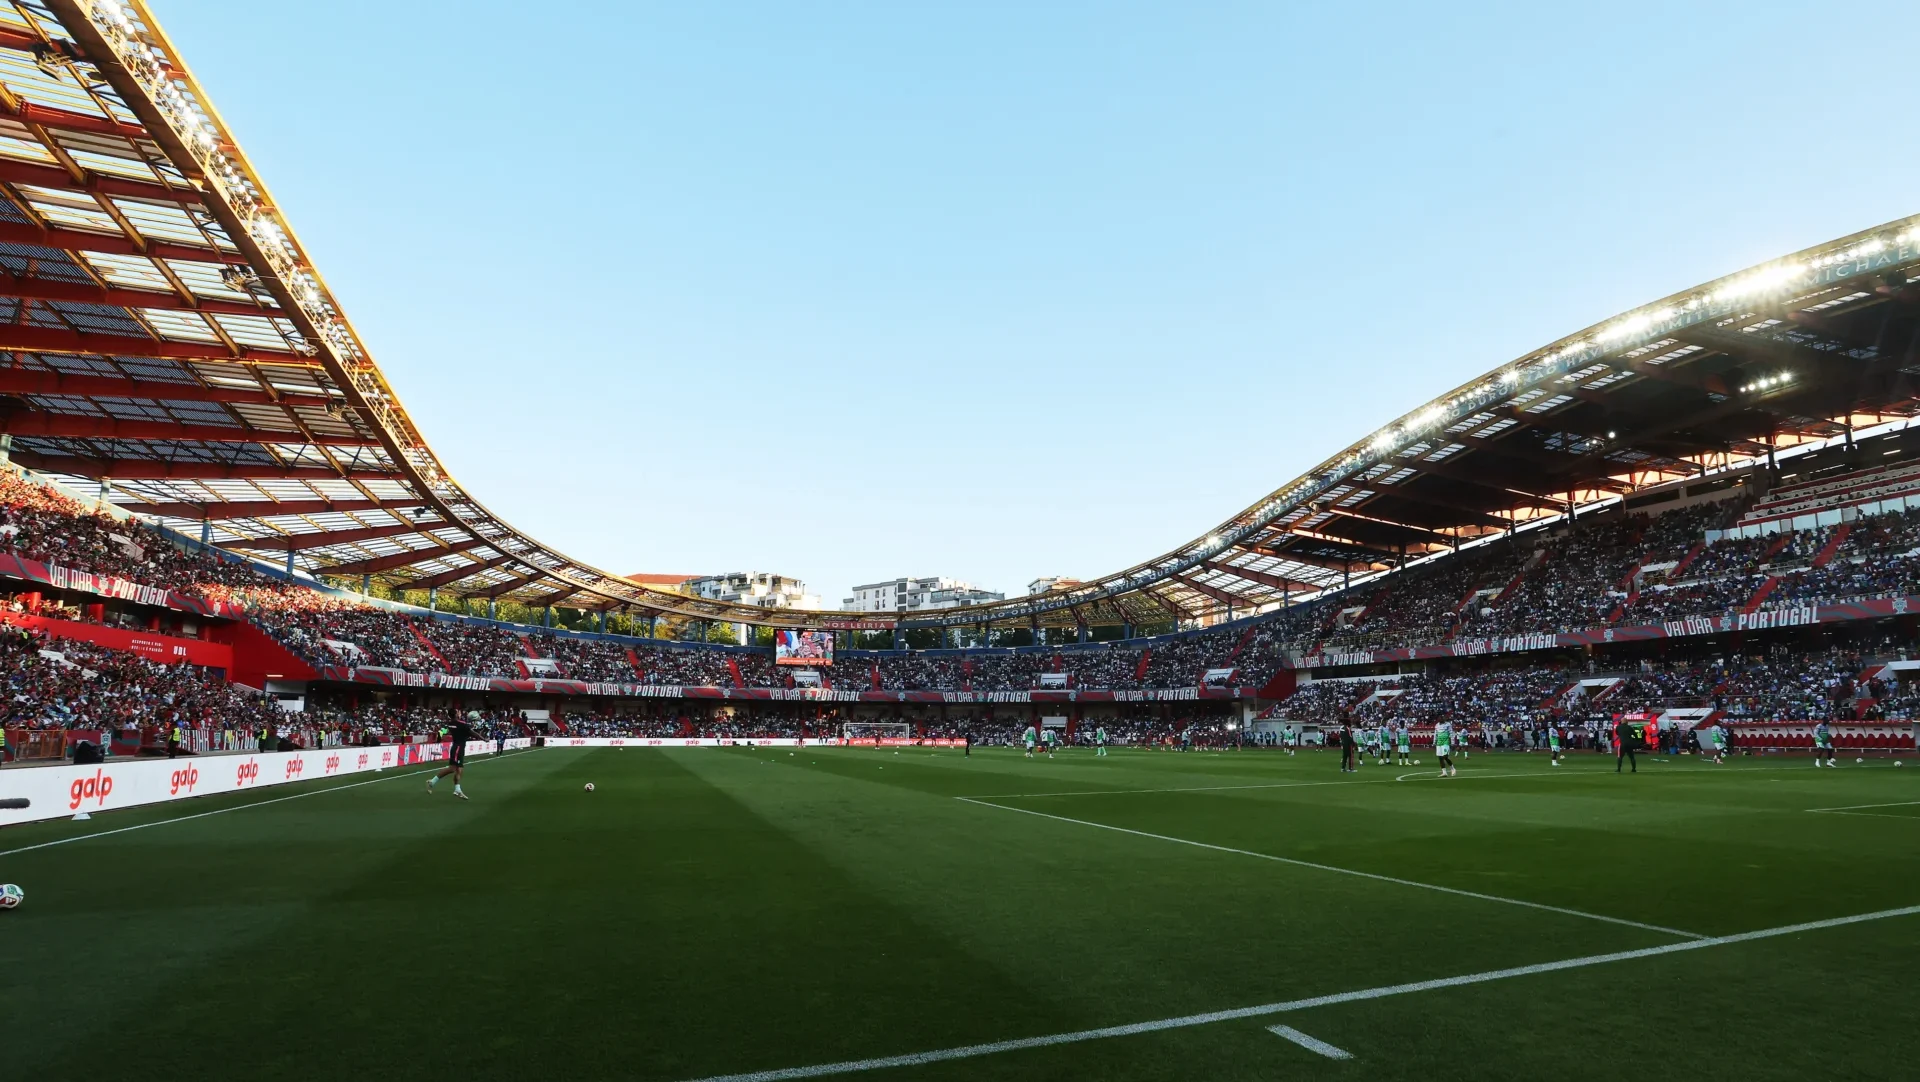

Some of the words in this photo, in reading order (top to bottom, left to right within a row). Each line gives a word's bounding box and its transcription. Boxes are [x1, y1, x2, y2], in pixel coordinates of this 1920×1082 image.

[1330, 465, 1353, 483] MAS
[50, 563, 67, 589] VAI
[71, 570, 92, 593] DAR
[112, 579, 170, 607] PORTUGAL
[1664, 619, 1685, 637] VAI
[1687, 617, 1713, 635] DAR
[1737, 606, 1821, 631] PORTUGAL
[1452, 641, 1467, 656] VAI
[1468, 639, 1487, 655] DAR
[1503, 634, 1558, 652] PORTUGAL
[1292, 658, 1304, 669] VAI
[1306, 656, 1320, 668] DAR
[1332, 651, 1375, 666] PORTUGAL
[392, 671, 406, 686] VAI
[407, 673, 424, 687] DAR
[439, 675, 491, 691] PORTUGAL
[585, 683, 600, 695] VAI
[602, 683, 619, 696] DAR
[635, 685, 683, 698] PORTUGAL
[769, 689, 783, 700] VAI
[785, 689, 800, 700] DAR
[815, 690, 860, 702] PORTUGAL
[943, 691, 957, 702] VAI
[958, 691, 973, 702] DAR
[987, 691, 1032, 703] PORTUGAL
[1113, 690, 1127, 702] VAI
[1128, 690, 1144, 702] DAR
[1157, 687, 1199, 701] PORTUGAL
[237, 757, 259, 786] galp
[286, 754, 303, 779] galp
[326, 752, 340, 774] galp
[70, 768, 113, 809] galp
[171, 762, 198, 795] galp
